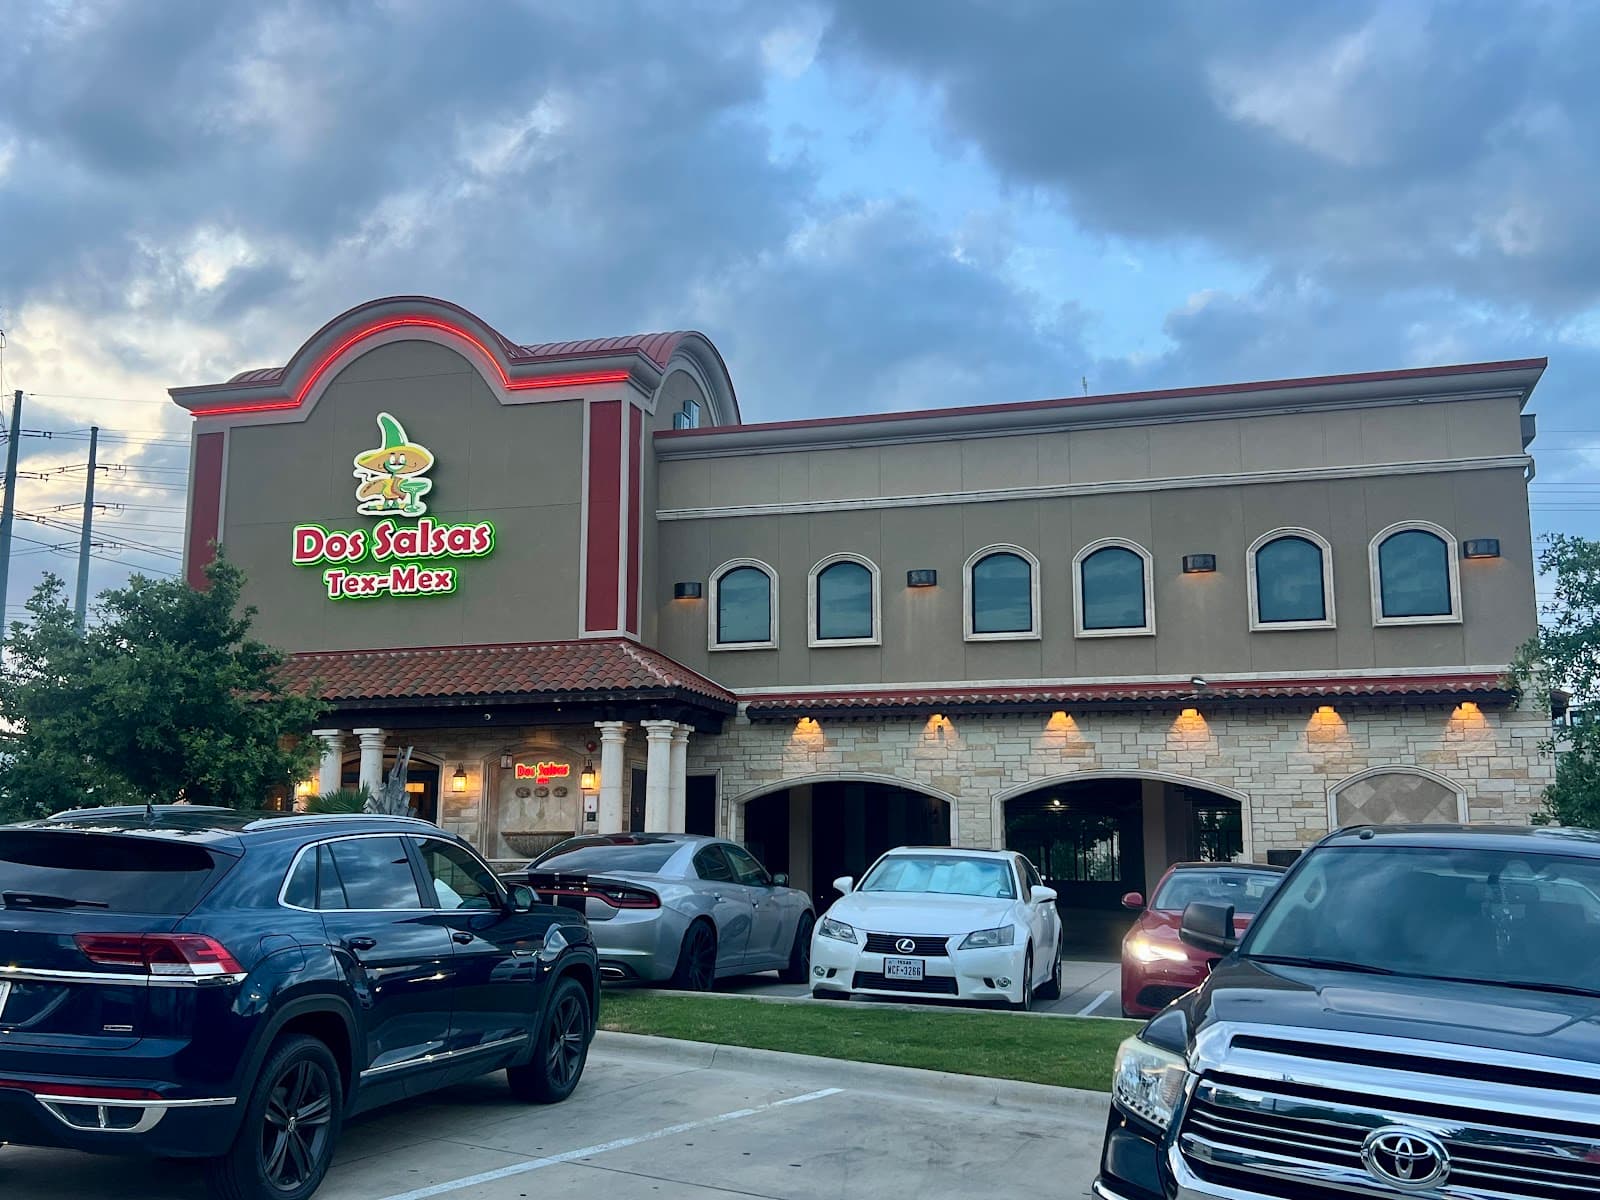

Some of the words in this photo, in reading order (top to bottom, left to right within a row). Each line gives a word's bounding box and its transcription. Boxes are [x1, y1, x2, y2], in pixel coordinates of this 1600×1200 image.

[294, 527, 366, 563] Dos
[373, 519, 492, 561] Salsas
[326, 566, 452, 597] Tex-Mex
